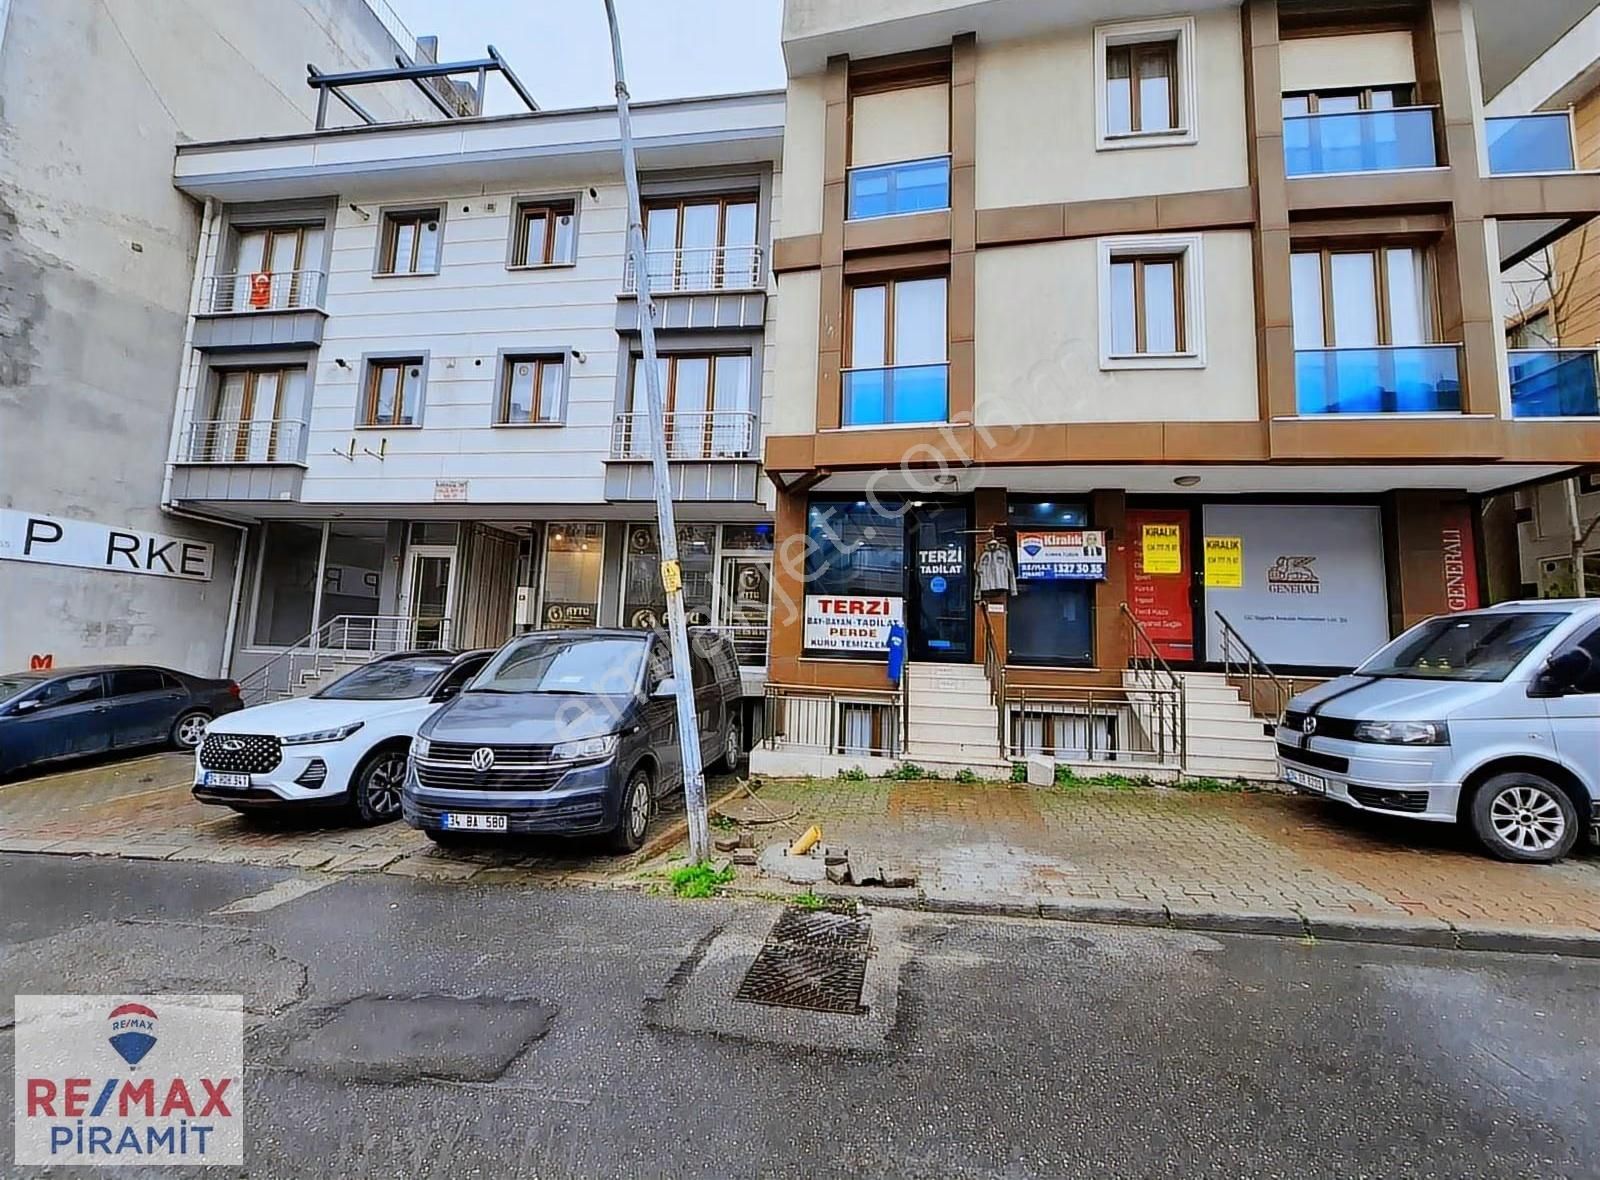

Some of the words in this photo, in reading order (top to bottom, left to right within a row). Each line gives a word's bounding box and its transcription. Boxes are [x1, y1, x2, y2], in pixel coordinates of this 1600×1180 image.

[1145, 527, 1177, 536] KIRALIK
[1206, 540, 1239, 550] KIRALIK
[919, 547, 962, 563] TERZİ
[920, 564, 962, 574] TADİLAT
[1442, 529, 1467, 611] GENERALI
[1269, 584, 1319, 594] GENERALI
[818, 598, 890, 615] TERZİ
[829, 628, 877, 638] PERDE
[449, 815, 460, 826] 34
